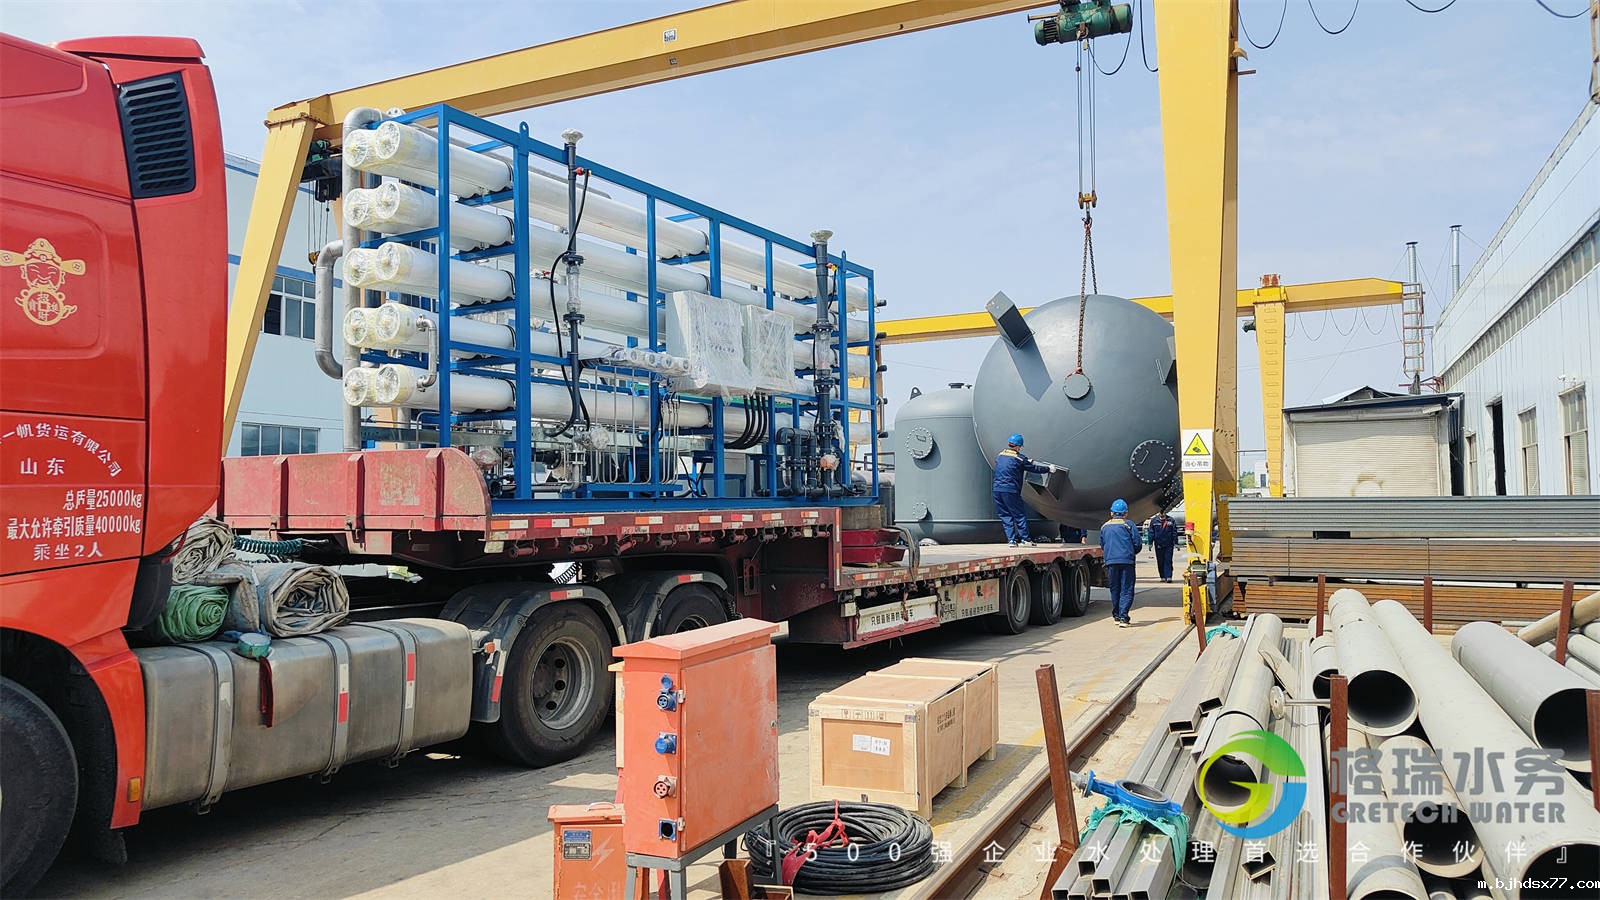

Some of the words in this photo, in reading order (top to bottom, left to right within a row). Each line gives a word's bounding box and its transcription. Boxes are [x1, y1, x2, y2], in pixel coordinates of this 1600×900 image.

[0, 422, 122, 477] 一帆货运有限公司
[20, 457, 66, 476] 山东
[7, 515, 141, 540] 最大允许牵引质量40000kg
